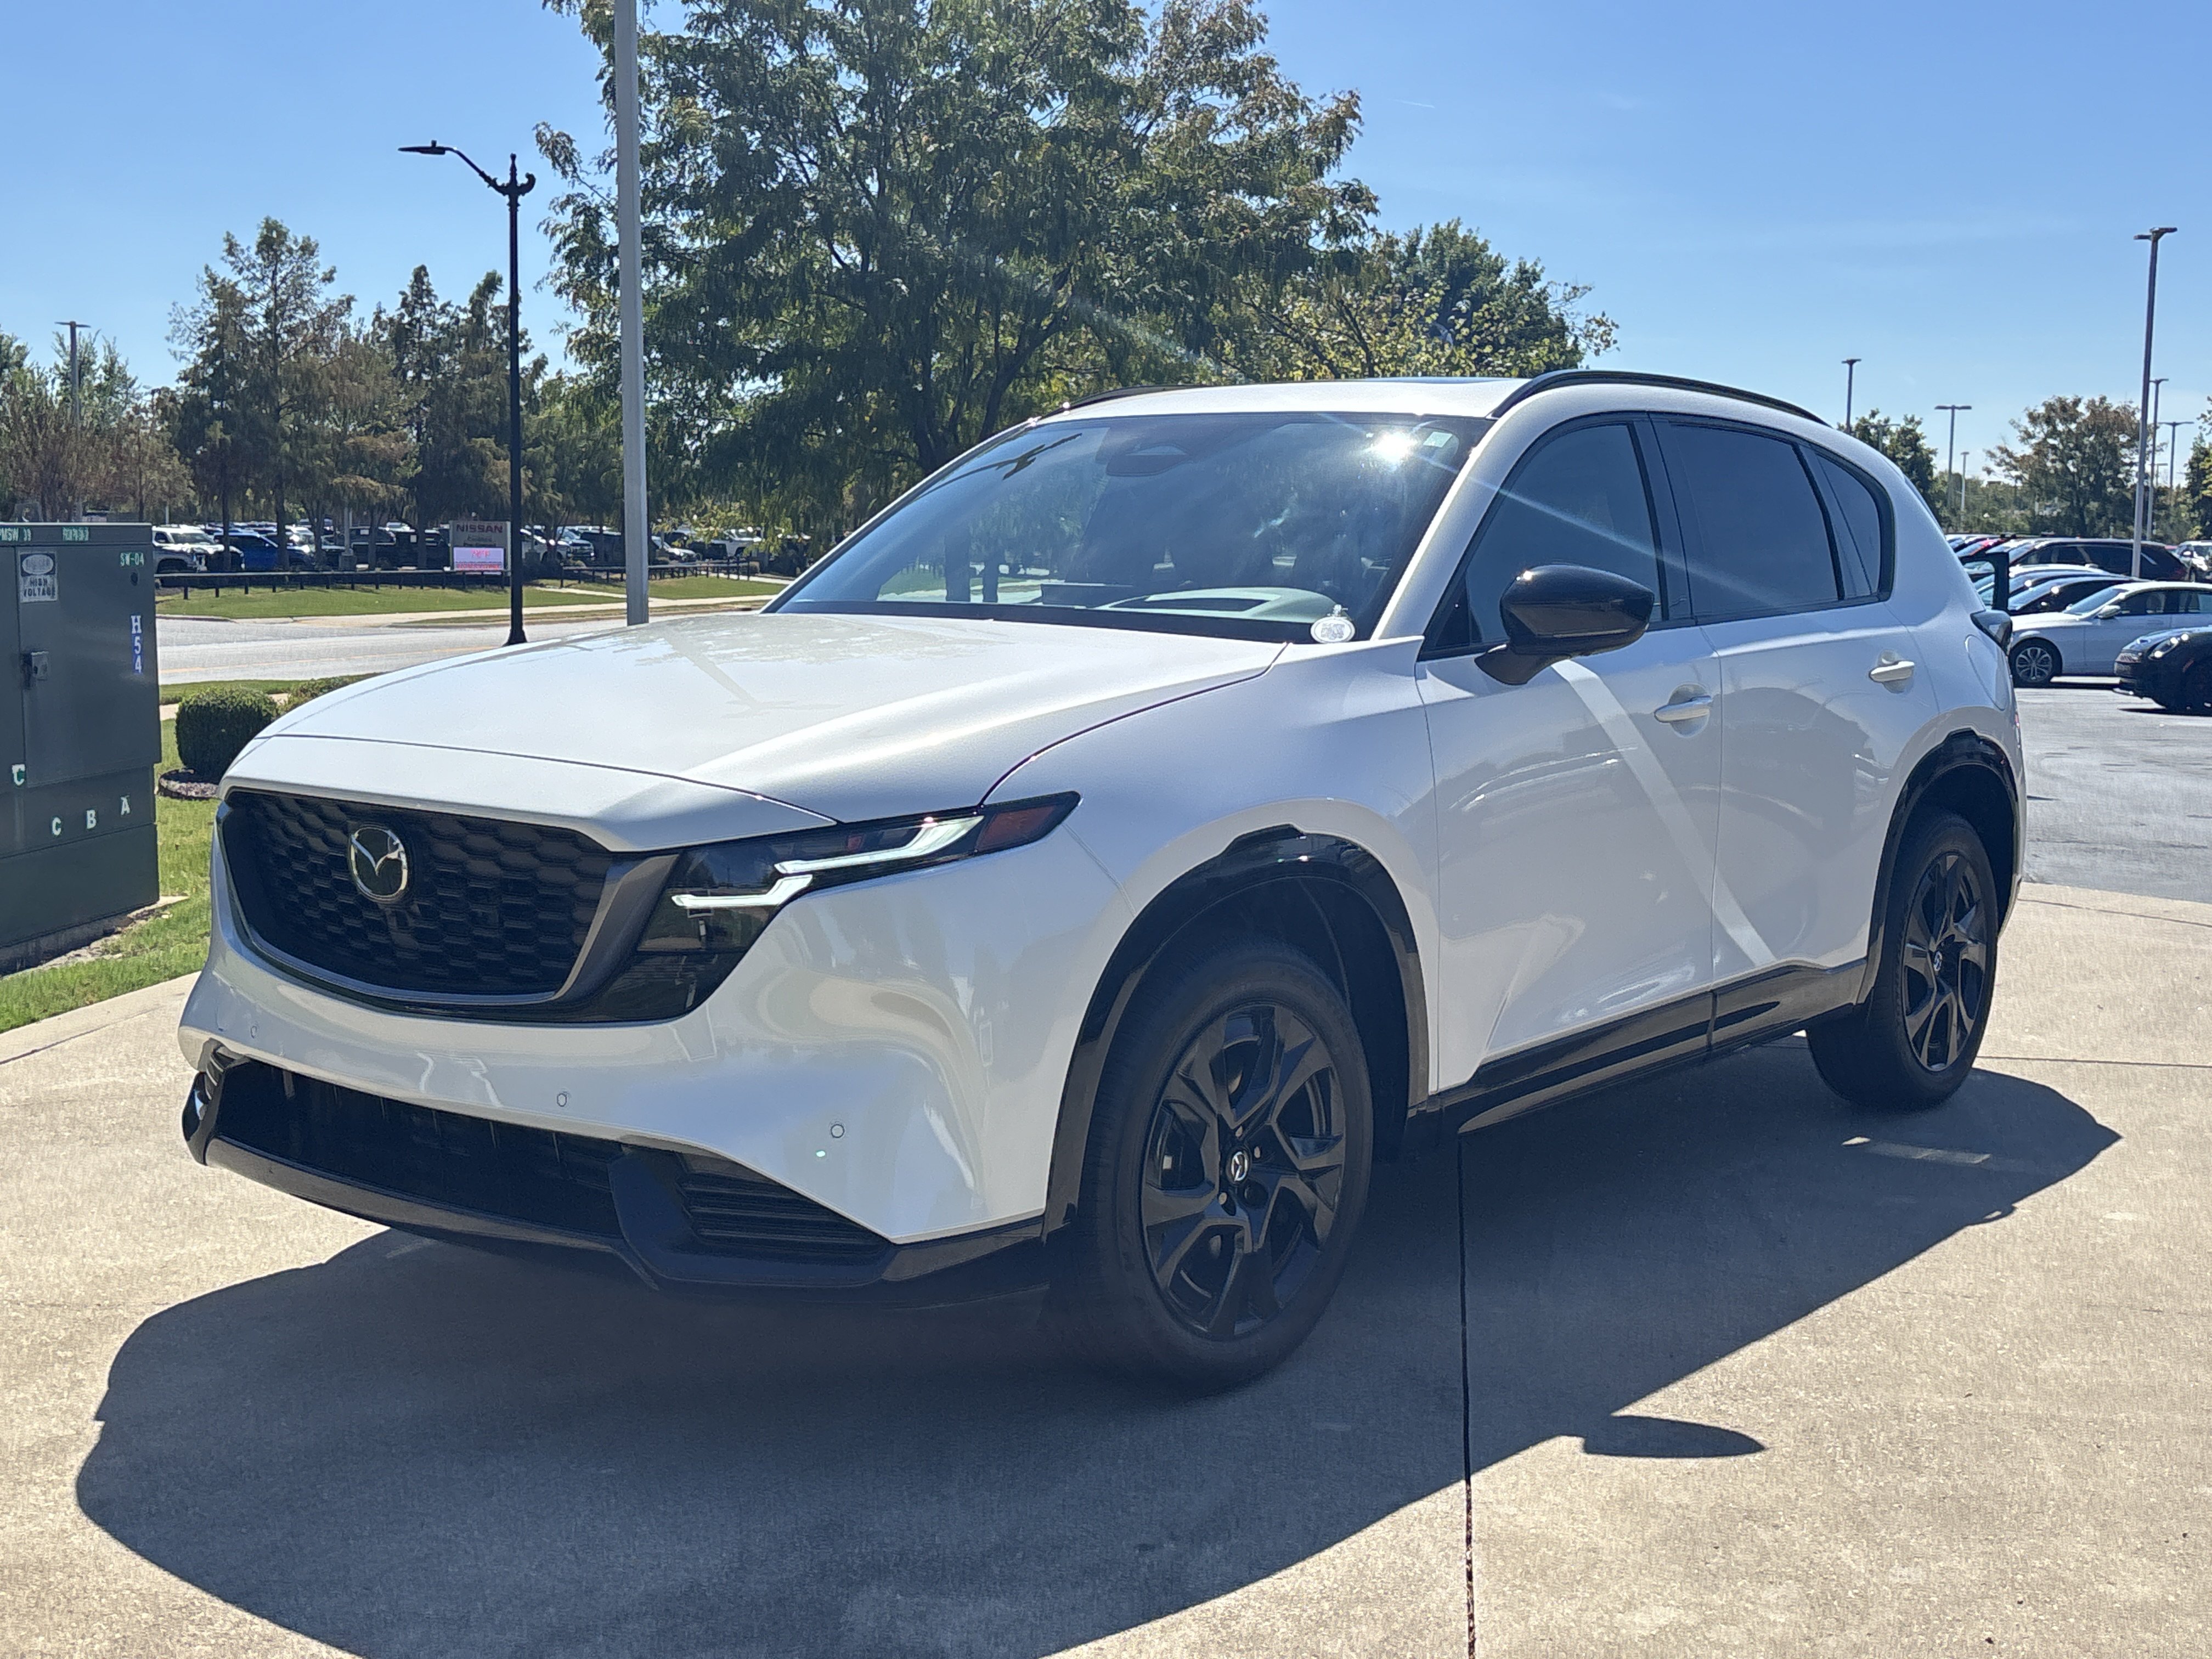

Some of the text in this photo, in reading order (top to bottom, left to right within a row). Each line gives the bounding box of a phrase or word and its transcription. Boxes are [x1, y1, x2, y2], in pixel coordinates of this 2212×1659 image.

[456, 524, 503, 533] NISSAN
[86, 809, 97, 829] B
[121, 796, 131, 816] A
